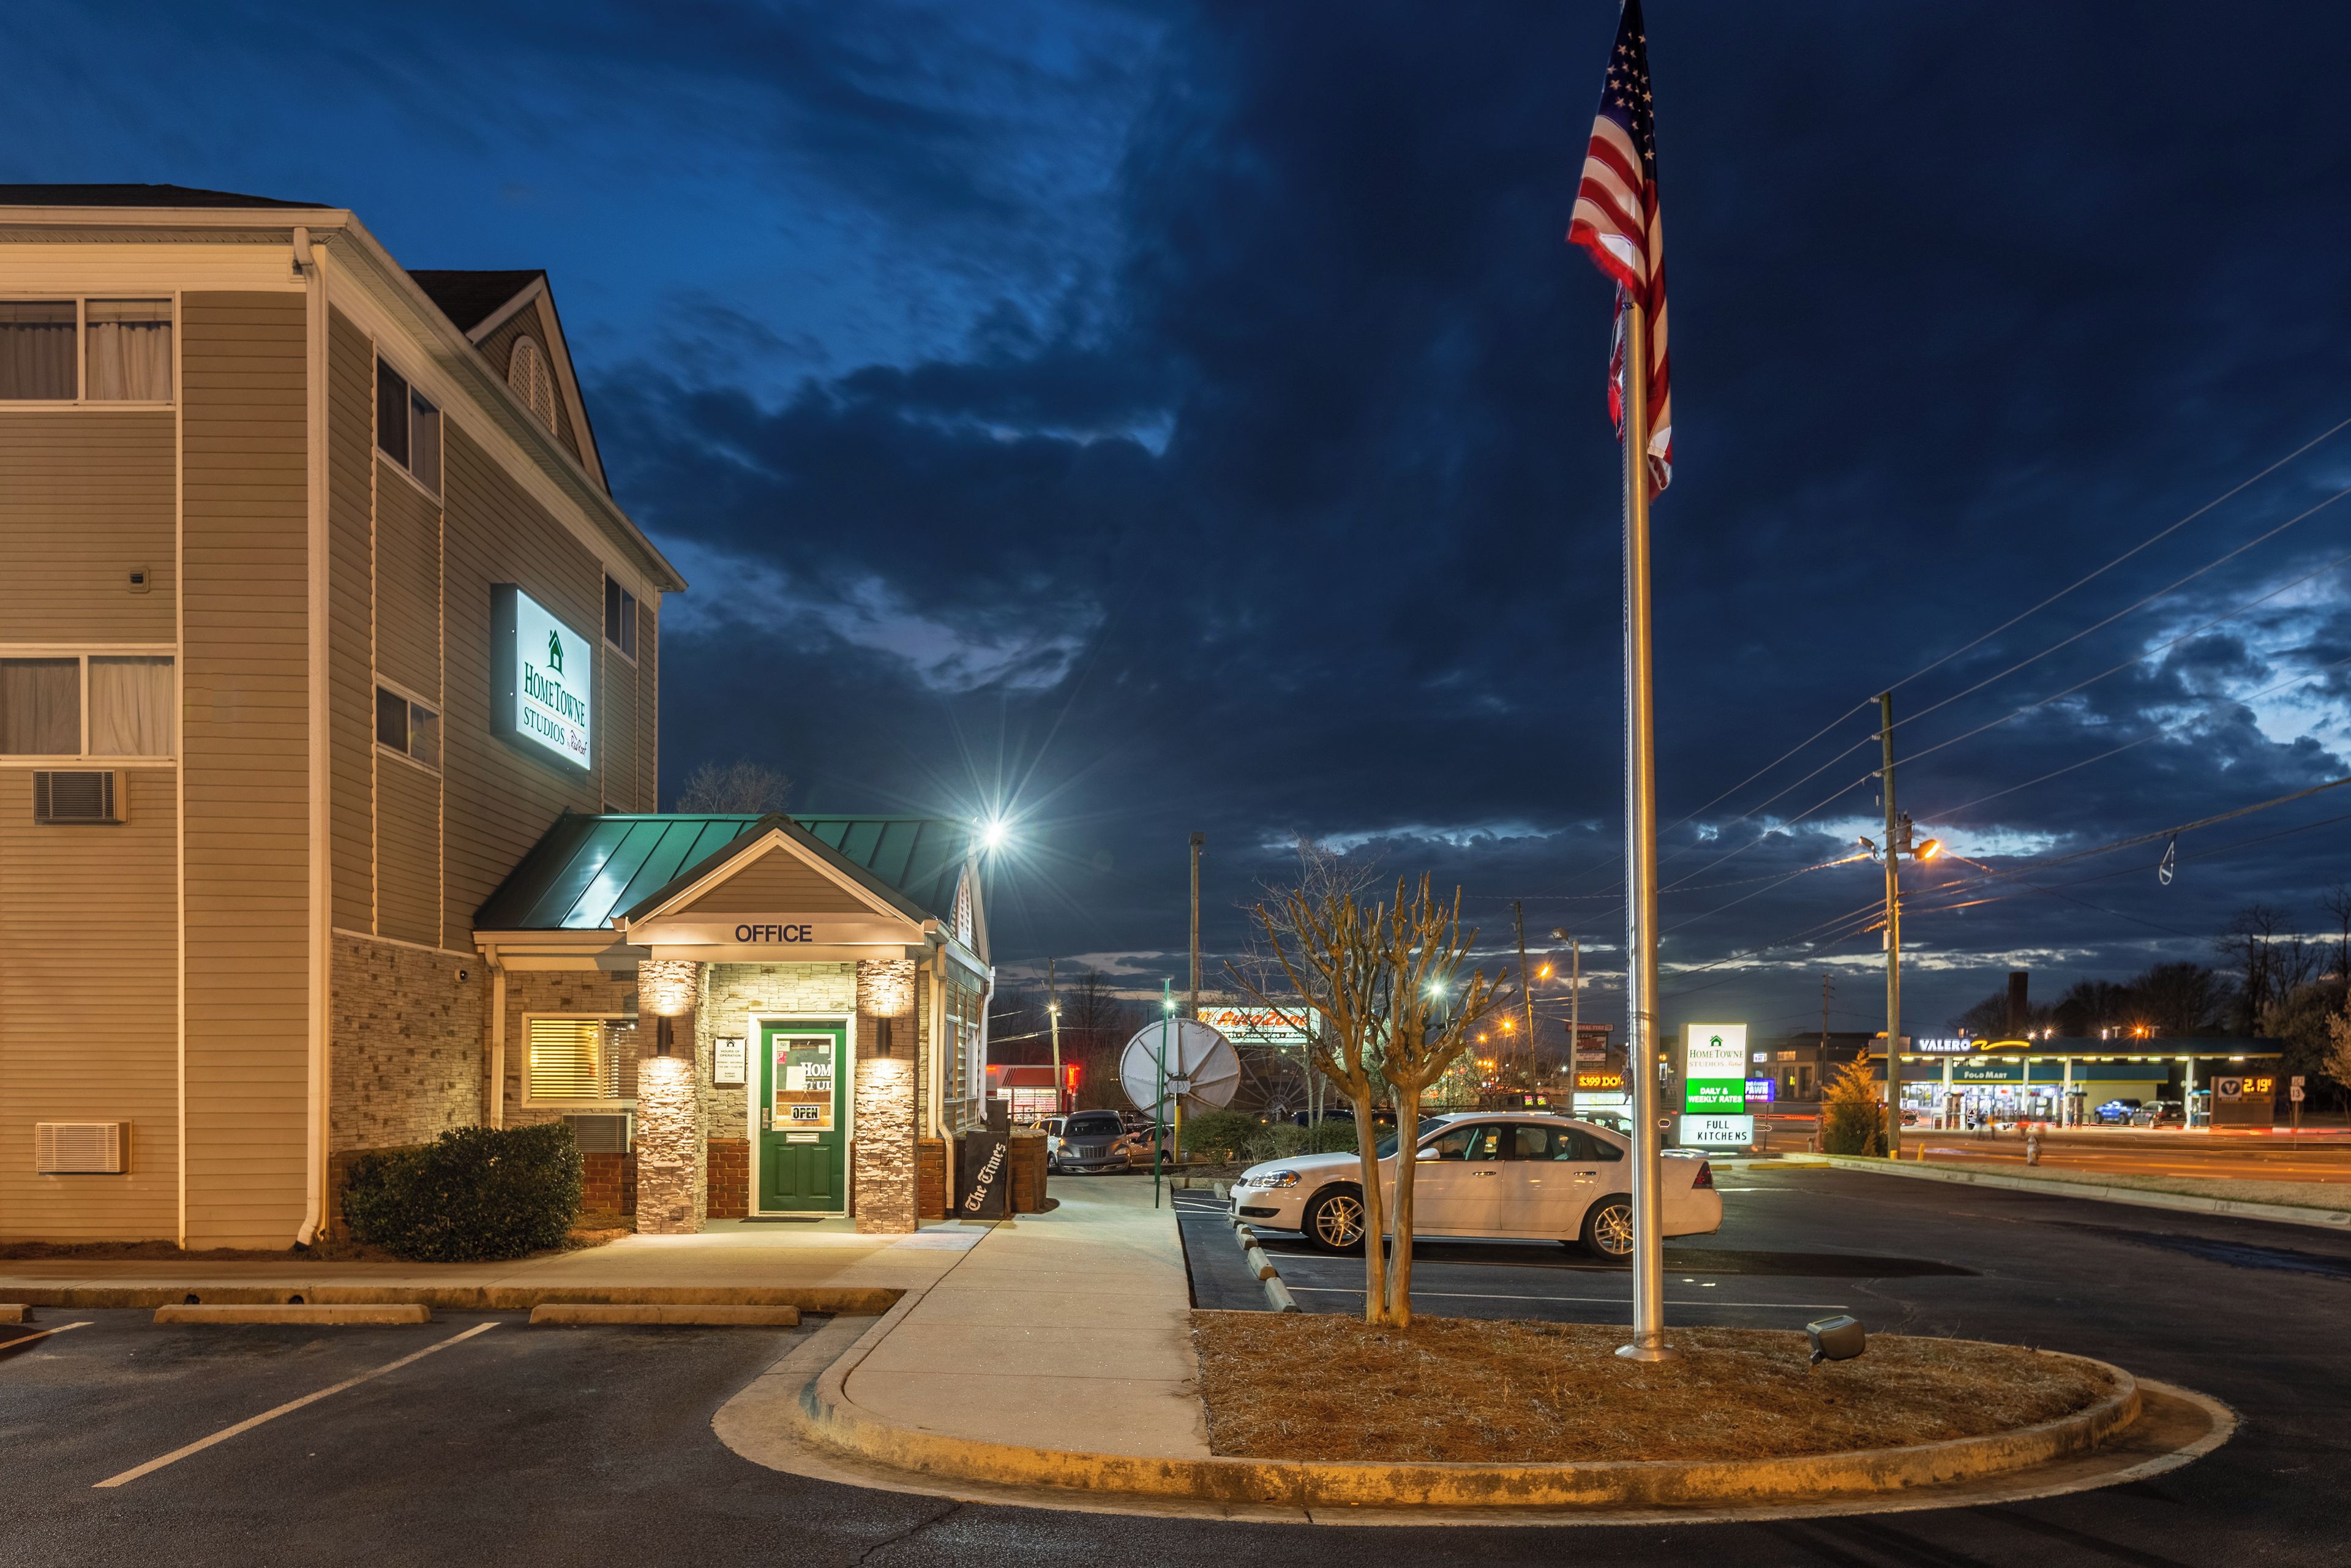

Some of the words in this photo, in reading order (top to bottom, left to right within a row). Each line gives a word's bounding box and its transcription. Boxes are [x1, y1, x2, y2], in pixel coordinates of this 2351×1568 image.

[523, 706, 565, 746] STUDIOS
[735, 925, 812, 942] OFFICE
[1215, 1011, 1310, 1026] AutoZone
[1919, 1039, 1971, 1051] VALERO
[1580, 1076, 1601, 1087] $399
[1745, 1086, 1769, 1095] PAWN
[2292, 1089, 2301, 1098] 13
[793, 1108, 818, 1119] OPEN
[1707, 1120, 1730, 1129] FULL
[1697, 1131, 1747, 1140] KITCHENS
[965, 1185, 988, 1212] The
[977, 1142, 1006, 1184] Times
